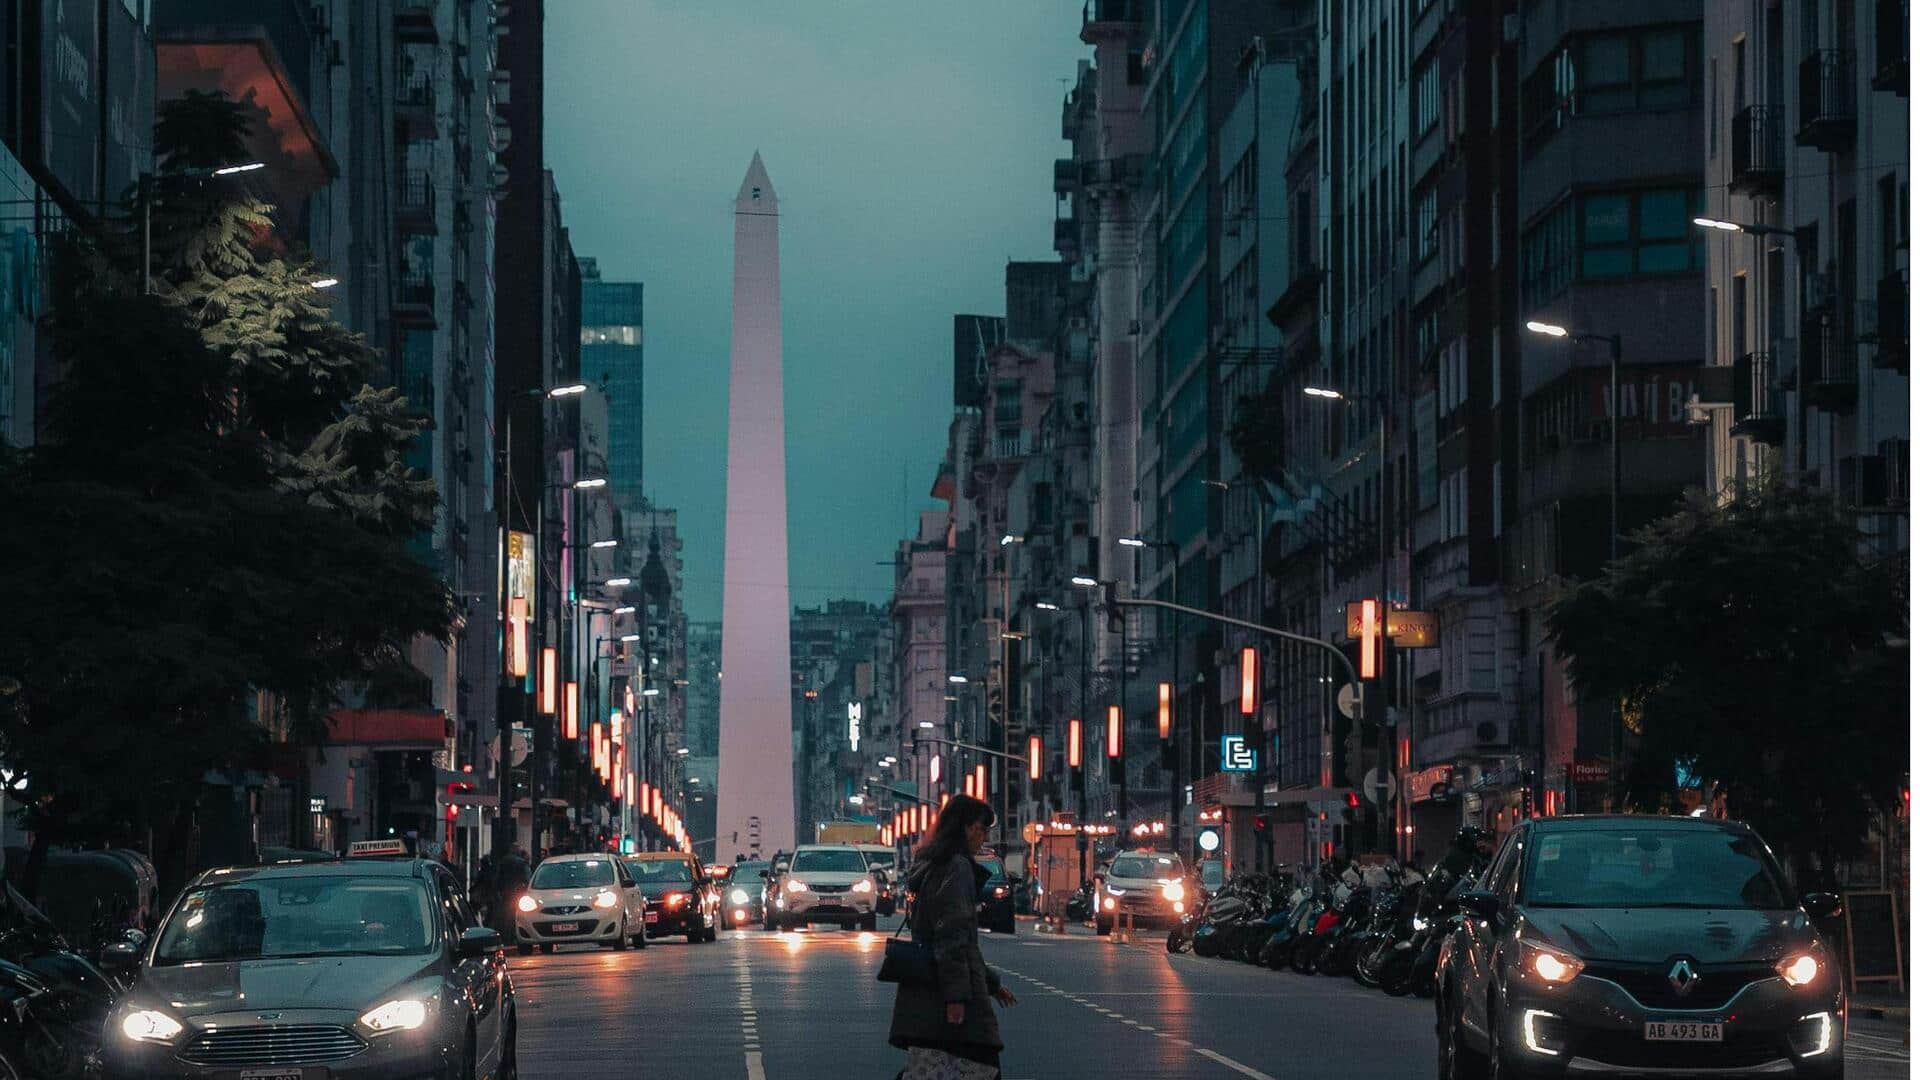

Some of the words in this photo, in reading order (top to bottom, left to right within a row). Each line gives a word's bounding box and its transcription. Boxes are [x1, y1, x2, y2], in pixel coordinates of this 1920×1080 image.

[353, 842, 368, 851] TAXI
[368, 841, 400, 850] PREMIUM
[1648, 1024, 1666, 1038] AB
[1671, 1024, 1697, 1039] 493
[1702, 1024, 1719, 1039] GA
